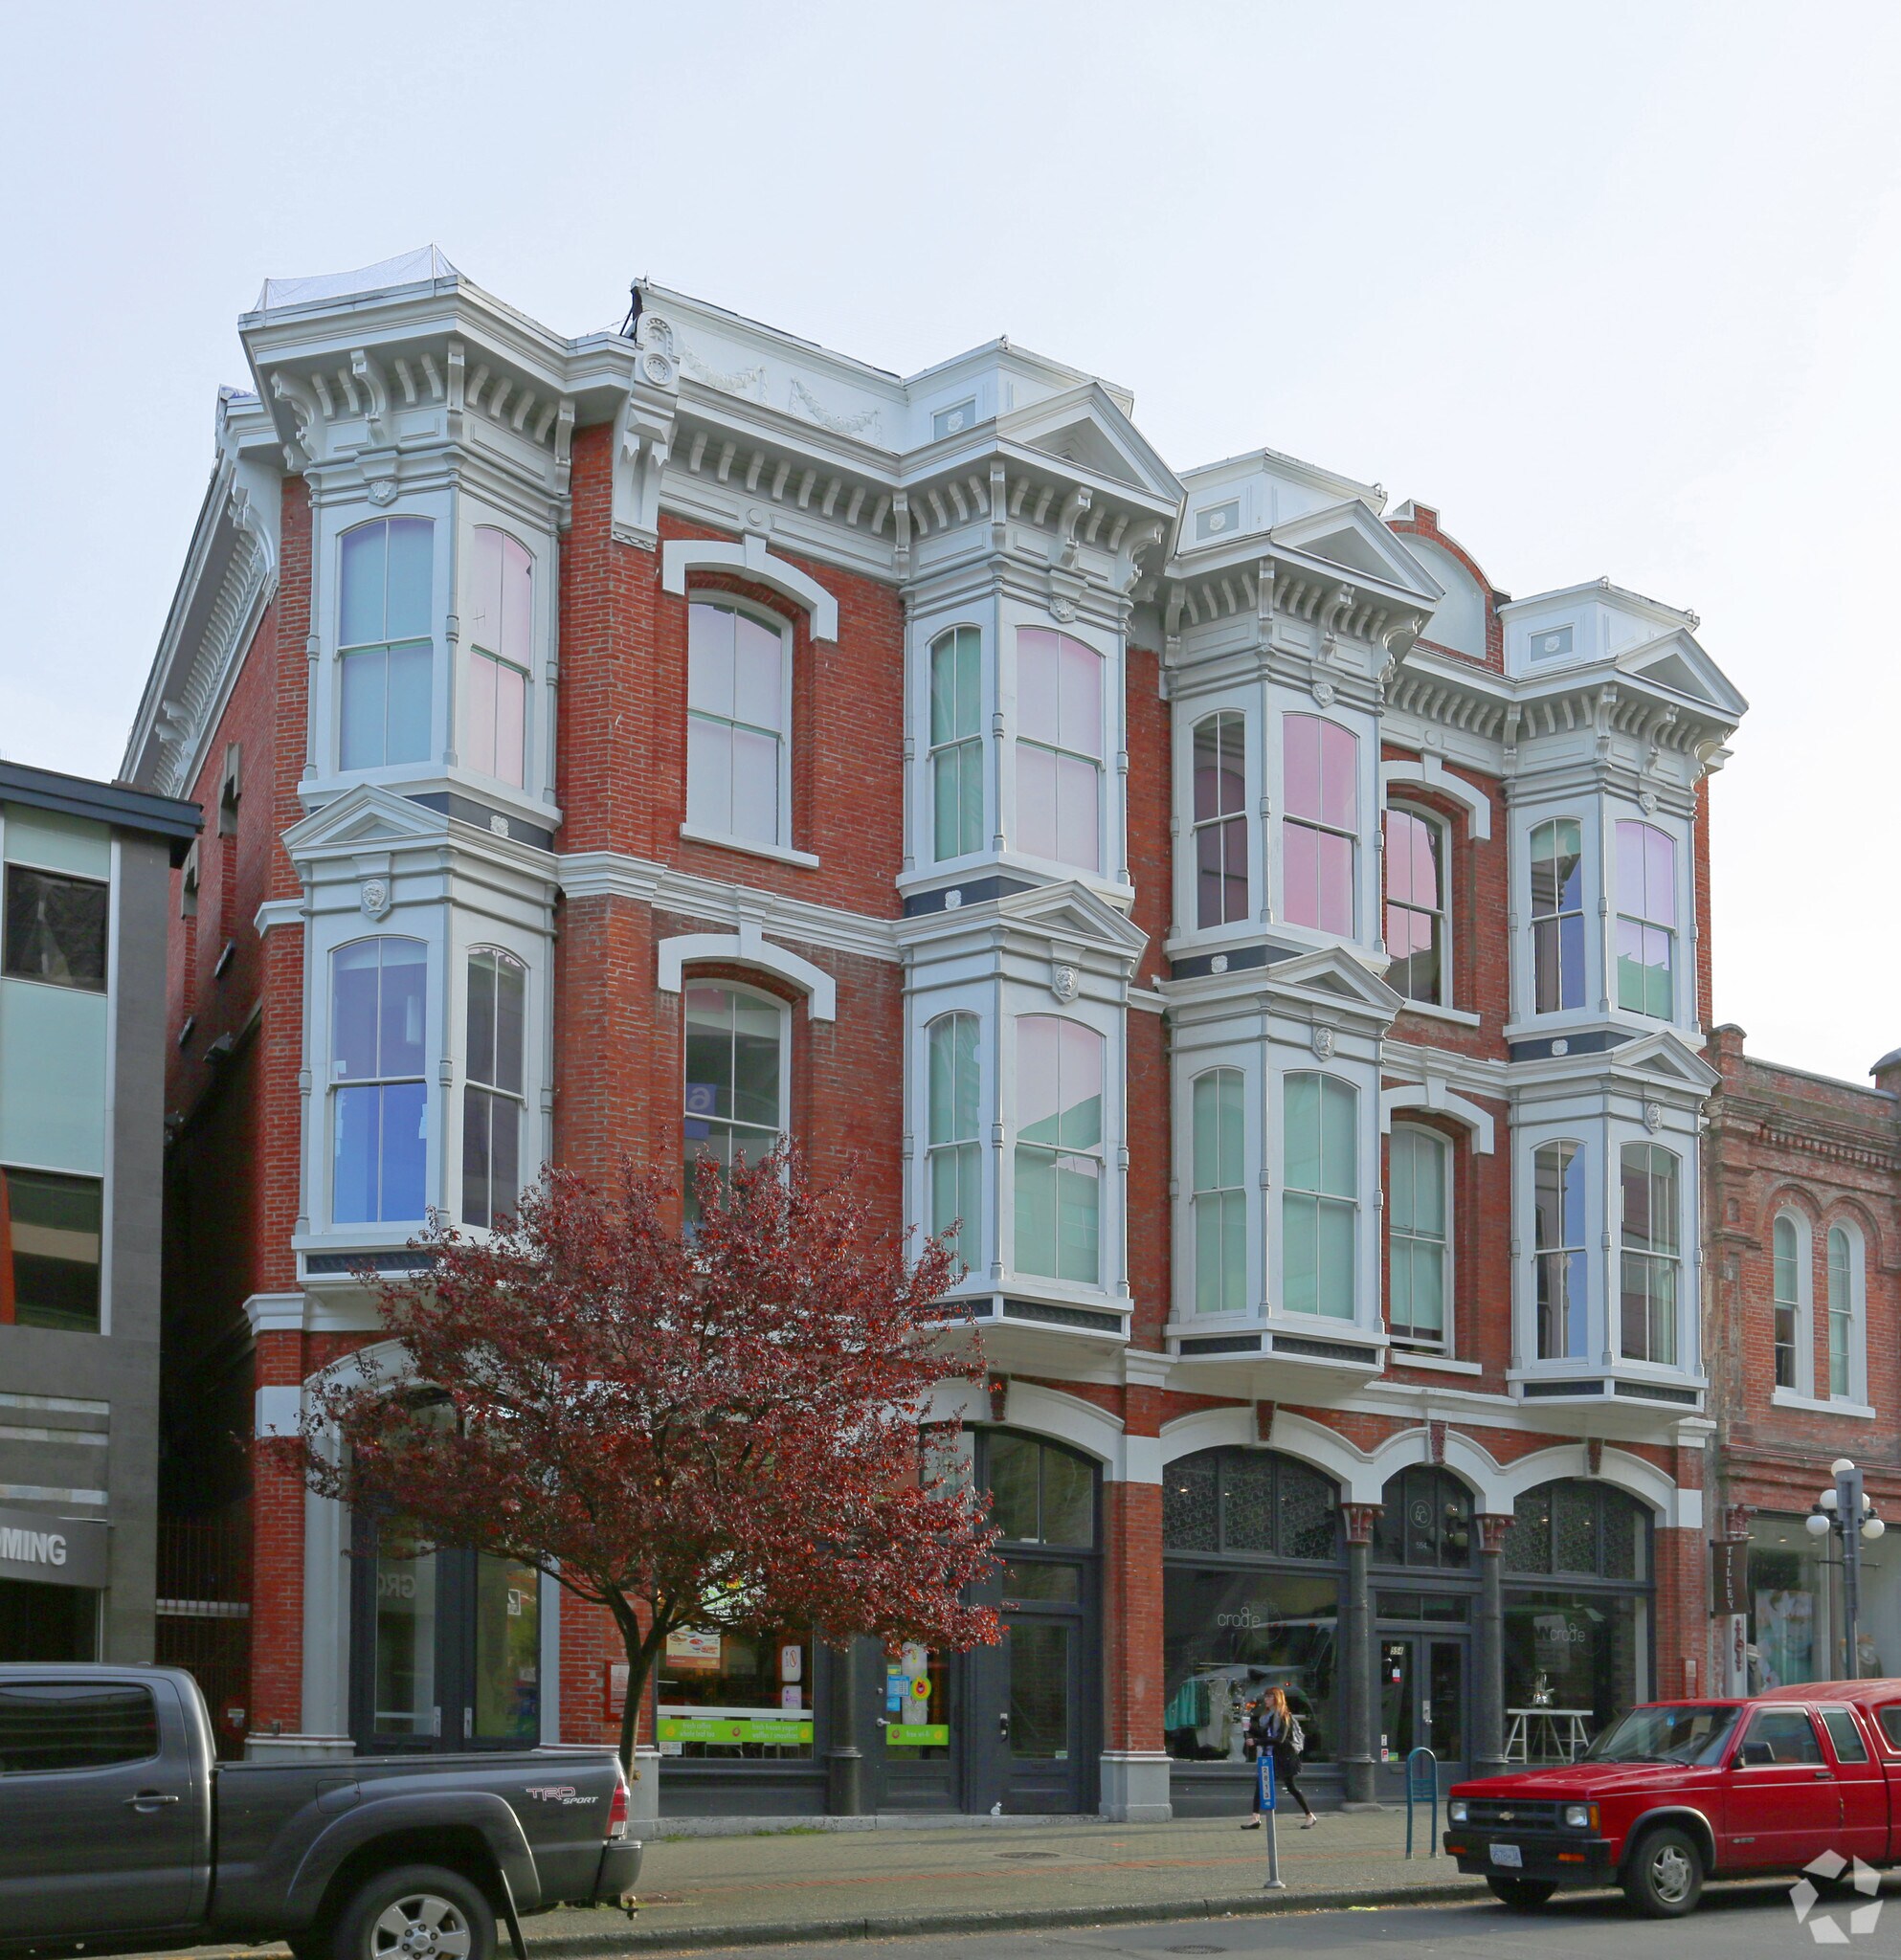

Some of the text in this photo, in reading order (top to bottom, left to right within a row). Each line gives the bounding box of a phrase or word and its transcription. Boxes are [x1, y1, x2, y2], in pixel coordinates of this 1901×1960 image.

[0, 1526, 66, 1566] MING
[526, 1787, 576, 1801] TRD
[562, 1796, 599, 1805] SPORT
